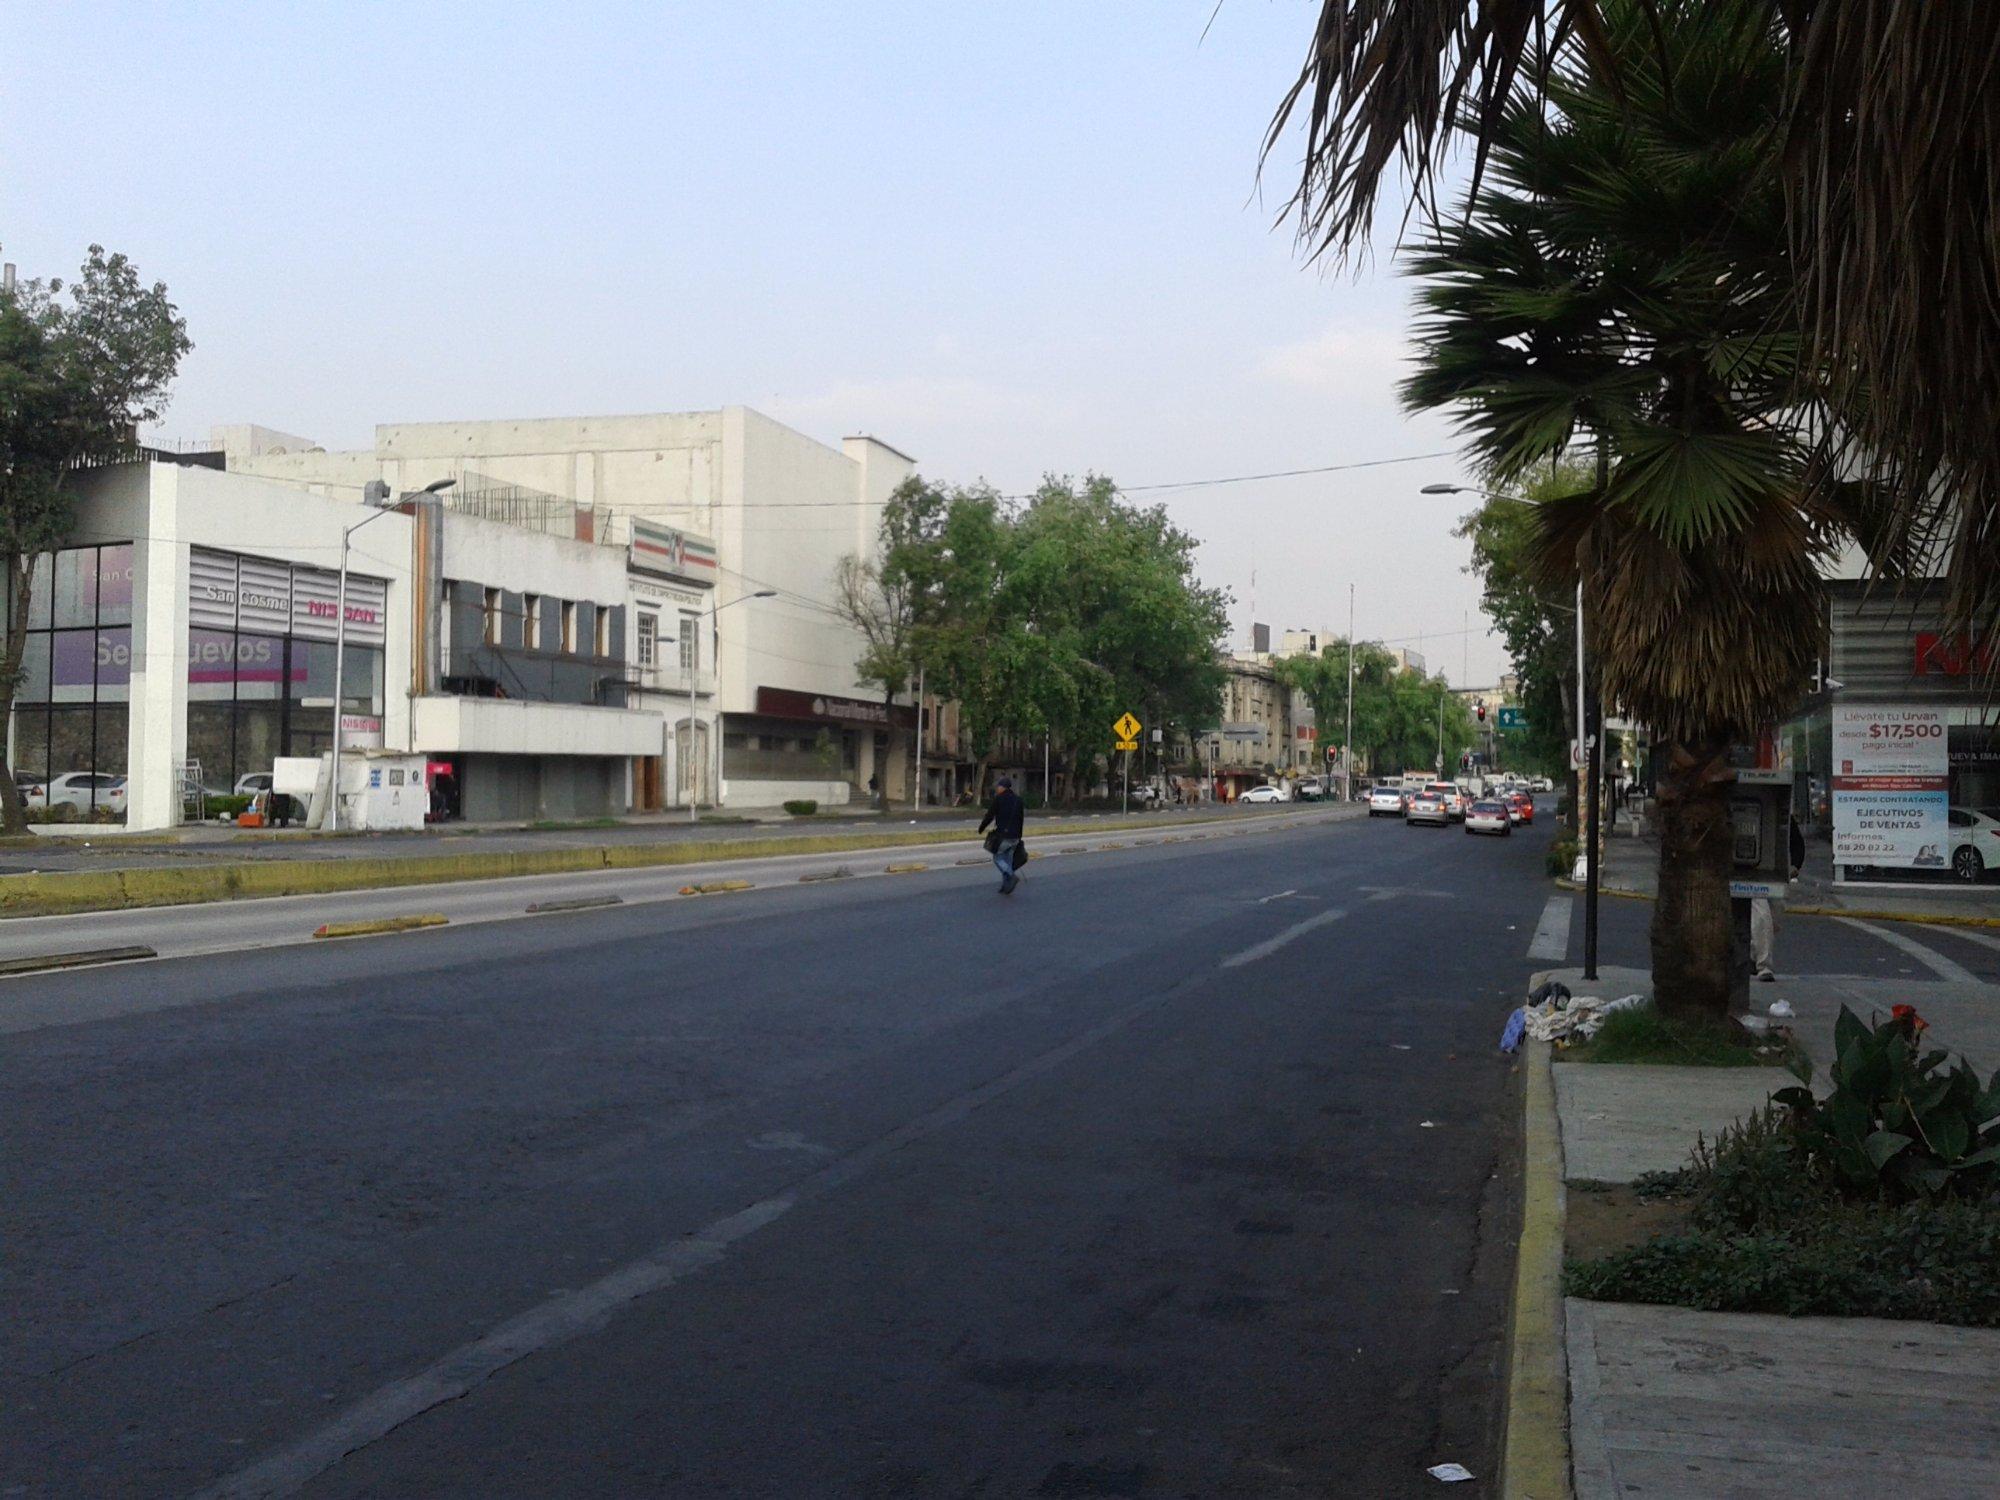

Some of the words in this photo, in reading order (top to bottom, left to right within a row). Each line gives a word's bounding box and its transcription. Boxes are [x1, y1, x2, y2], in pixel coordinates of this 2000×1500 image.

[205, 585, 235, 603] San
[240, 589, 288, 611] Cosme
[1887, 712, 1899, 721] tu
[1839, 730, 1867, 738] desde
[1869, 722, 1942, 740] $17,500
[1861, 741, 1886, 750] pago
[1980, 752, 2000, 760] IMA
[1838, 796, 1878, 804] ESTAMOS
[1880, 796, 1943, 804] CONTRATANDO
[1856, 809, 1924, 818] EJECUTIVOS
[1860, 820, 1874, 829] DE
[1877, 820, 1921, 830] VENTAS
[1837, 832, 1886, 841] Informes:
[1853, 843, 1866, 851] 20
[1882, 844, 1895, 852] 22
